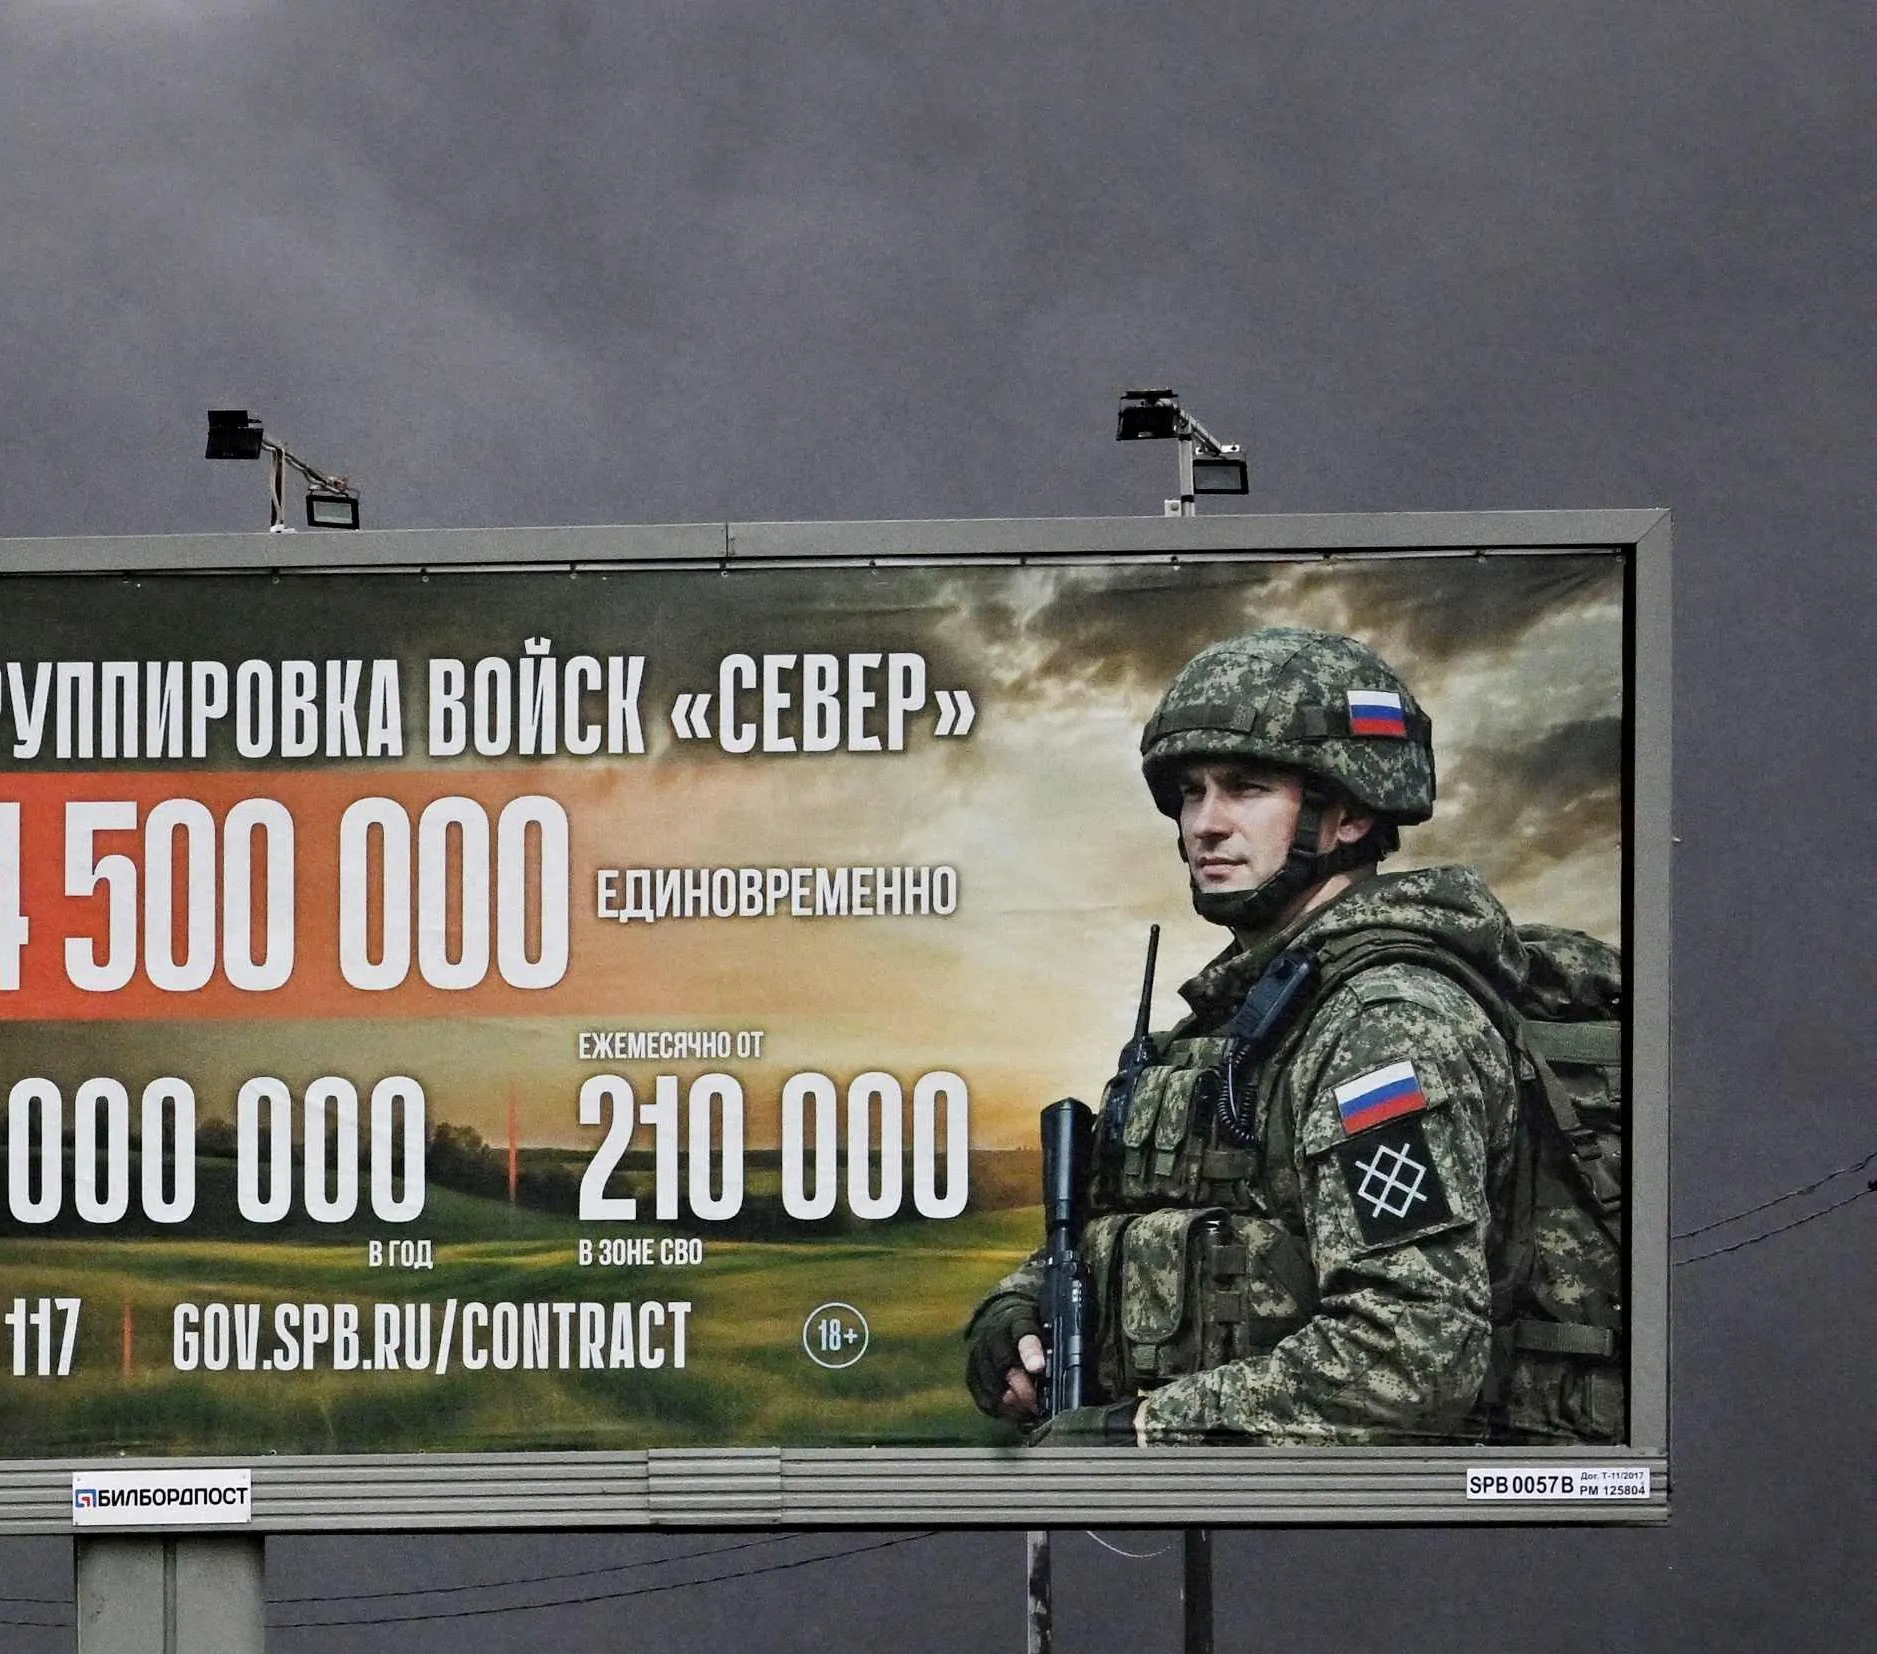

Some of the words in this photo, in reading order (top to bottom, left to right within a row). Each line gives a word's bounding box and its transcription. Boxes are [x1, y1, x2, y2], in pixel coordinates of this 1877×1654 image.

[429, 637, 645, 756] ВОЙСК
[671, 652, 976, 754] «СЕВЕР»
[64, 798, 295, 992] 500
[339, 795, 569, 991] 000
[597, 864, 957, 923] ЕДИНОВРЕМЕННО
[579, 1031, 731, 1059] ЕЖЕМЕСЯЧНО
[737, 1031, 764, 1058] ОТ
[8, 1077, 196, 1224] 000
[237, 1075, 426, 1223] 000
[579, 1073, 744, 1221] 210
[782, 1071, 969, 1220] 000
[369, 1240, 383, 1267] В
[388, 1239, 434, 1270] ГОД
[579, 1239, 593, 1266] В
[598, 1238, 655, 1266] ЗОНЕ
[660, 1237, 703, 1266] СВО
[4, 1298, 82, 1376] 117
[173, 1298, 692, 1375] GOV.SPB.RU/CONTRACT
[817, 1318, 859, 1352] 18+
[98, 1486, 248, 1508] БИЛБОРДПОСТ
[1470, 1476, 1509, 1494] SPB
